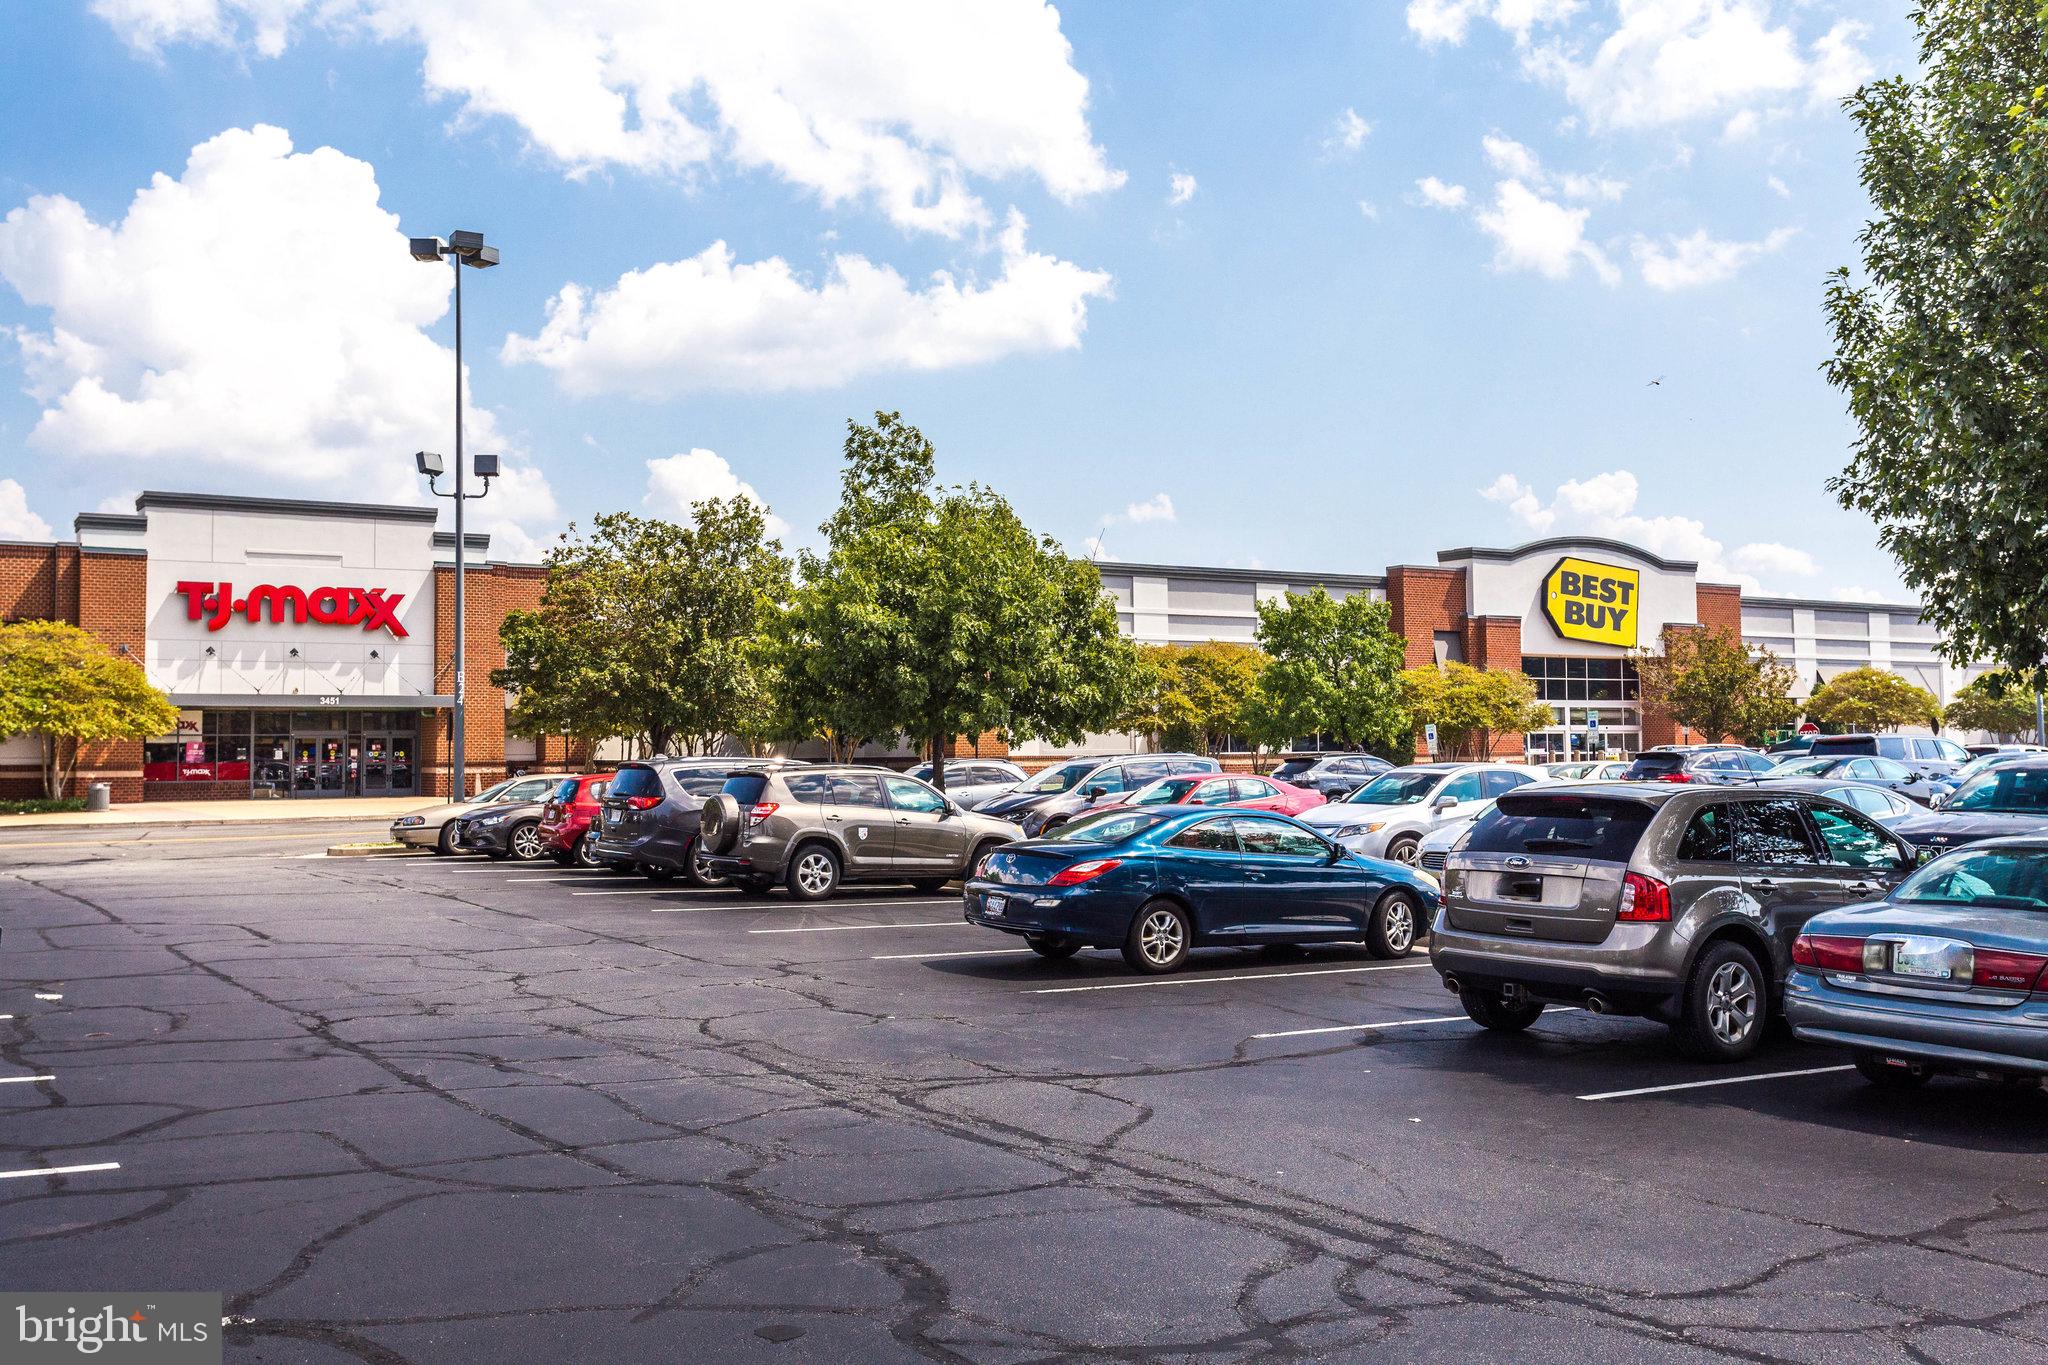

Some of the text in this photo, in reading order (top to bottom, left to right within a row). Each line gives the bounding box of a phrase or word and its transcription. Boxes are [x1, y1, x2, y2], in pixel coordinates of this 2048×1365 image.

[1561, 571, 1634, 605] BEST
[1565, 600, 1628, 632] BUY
[319, 696, 340, 705] 3451
